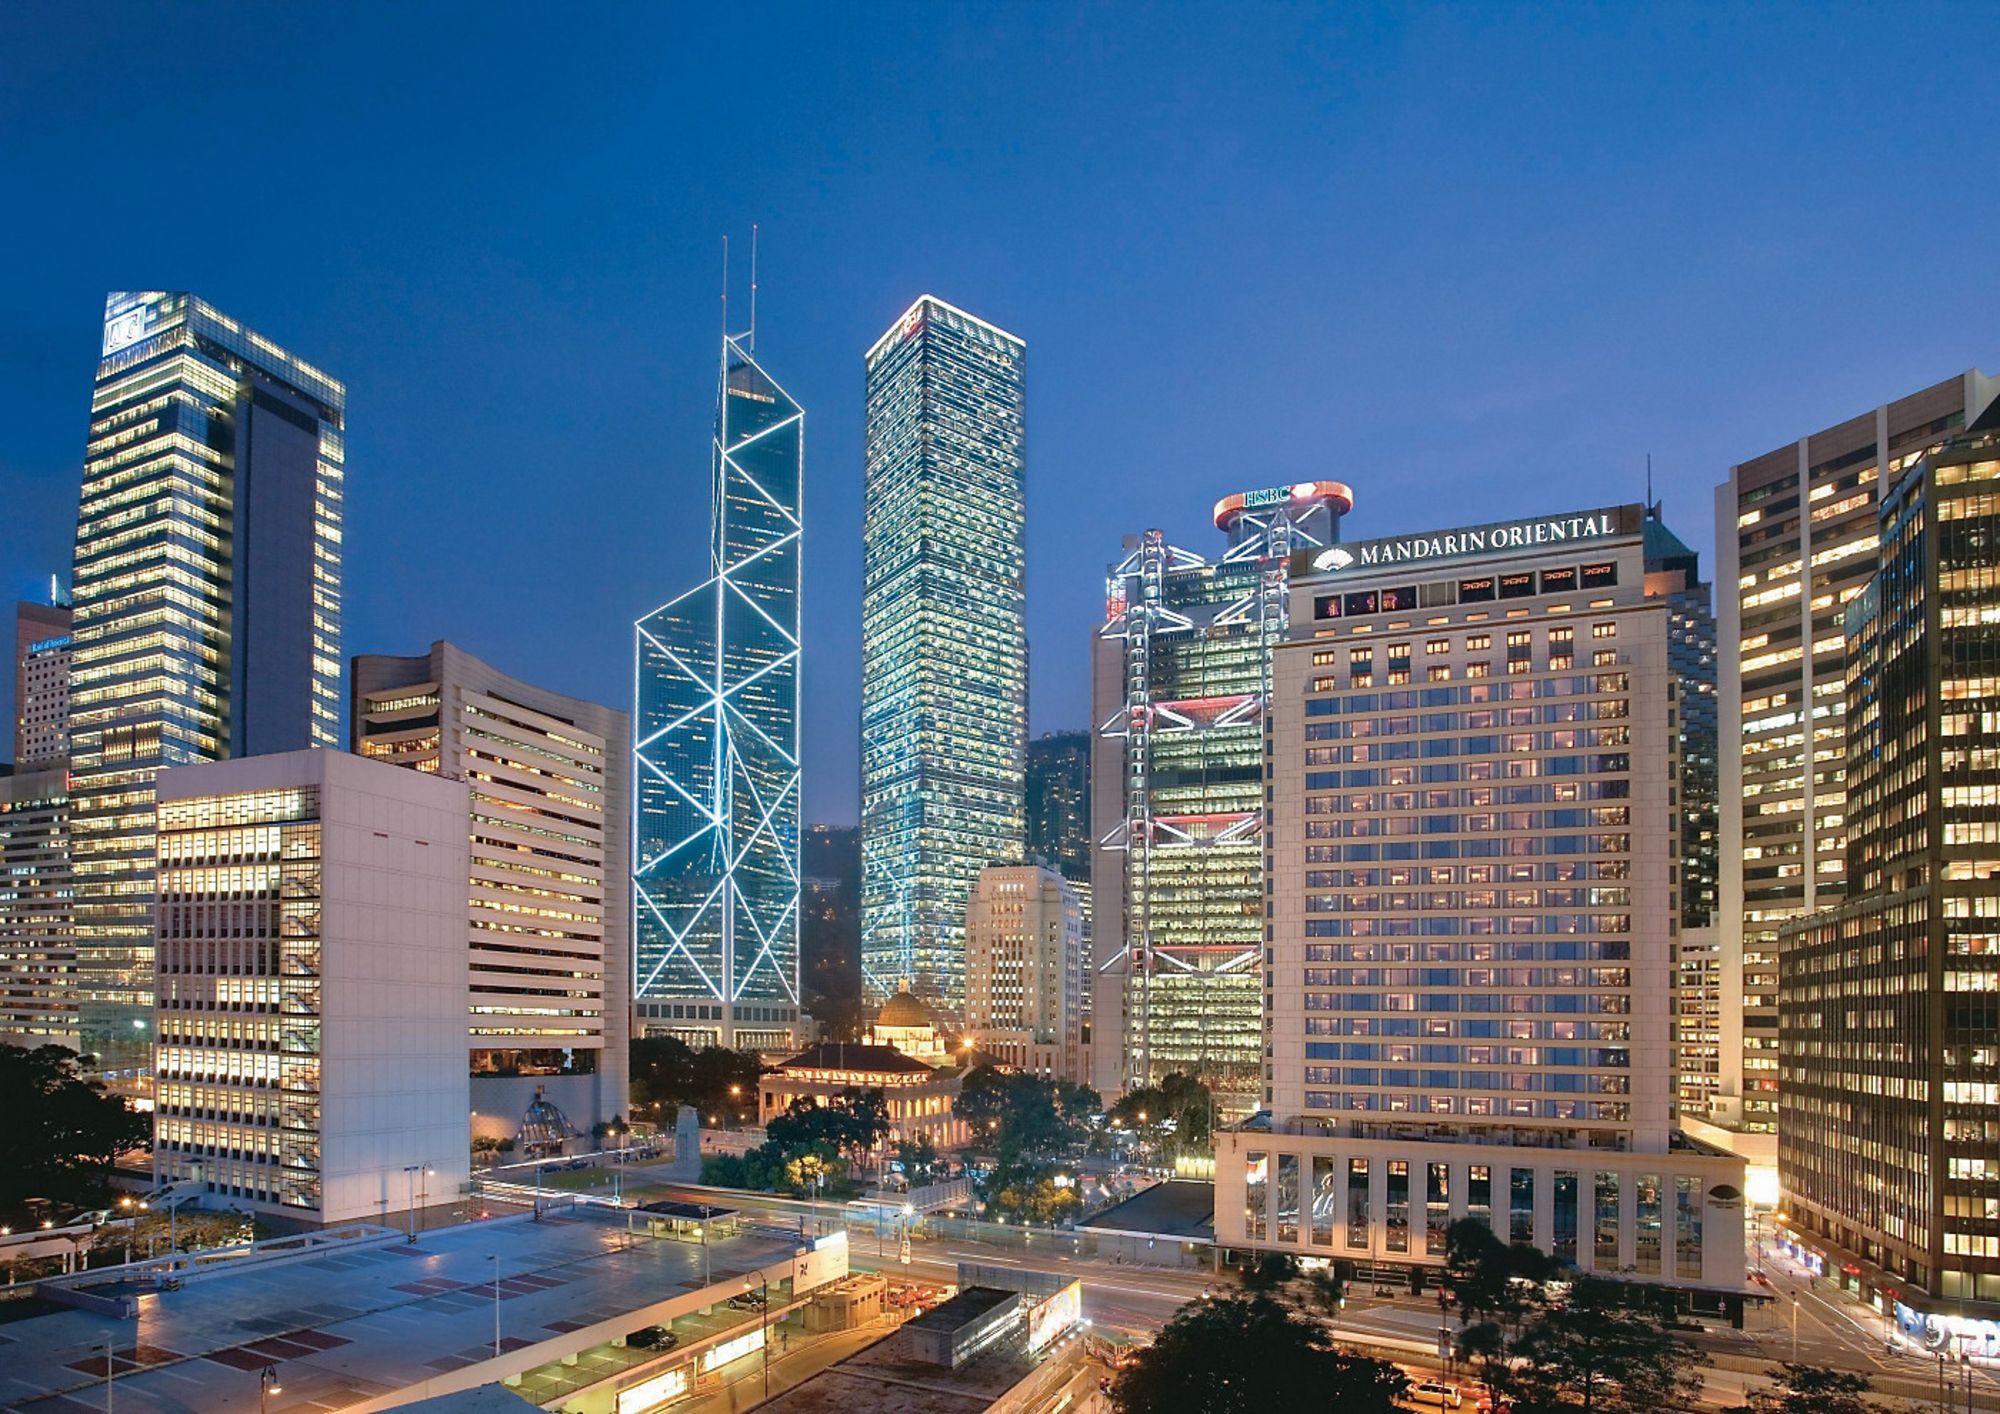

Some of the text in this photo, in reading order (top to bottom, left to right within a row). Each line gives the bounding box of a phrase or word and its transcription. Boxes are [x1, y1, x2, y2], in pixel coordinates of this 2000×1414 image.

[1242, 486, 1291, 508] HSBC
[1360, 515, 1615, 566] MANDARIN ORIENTAL
